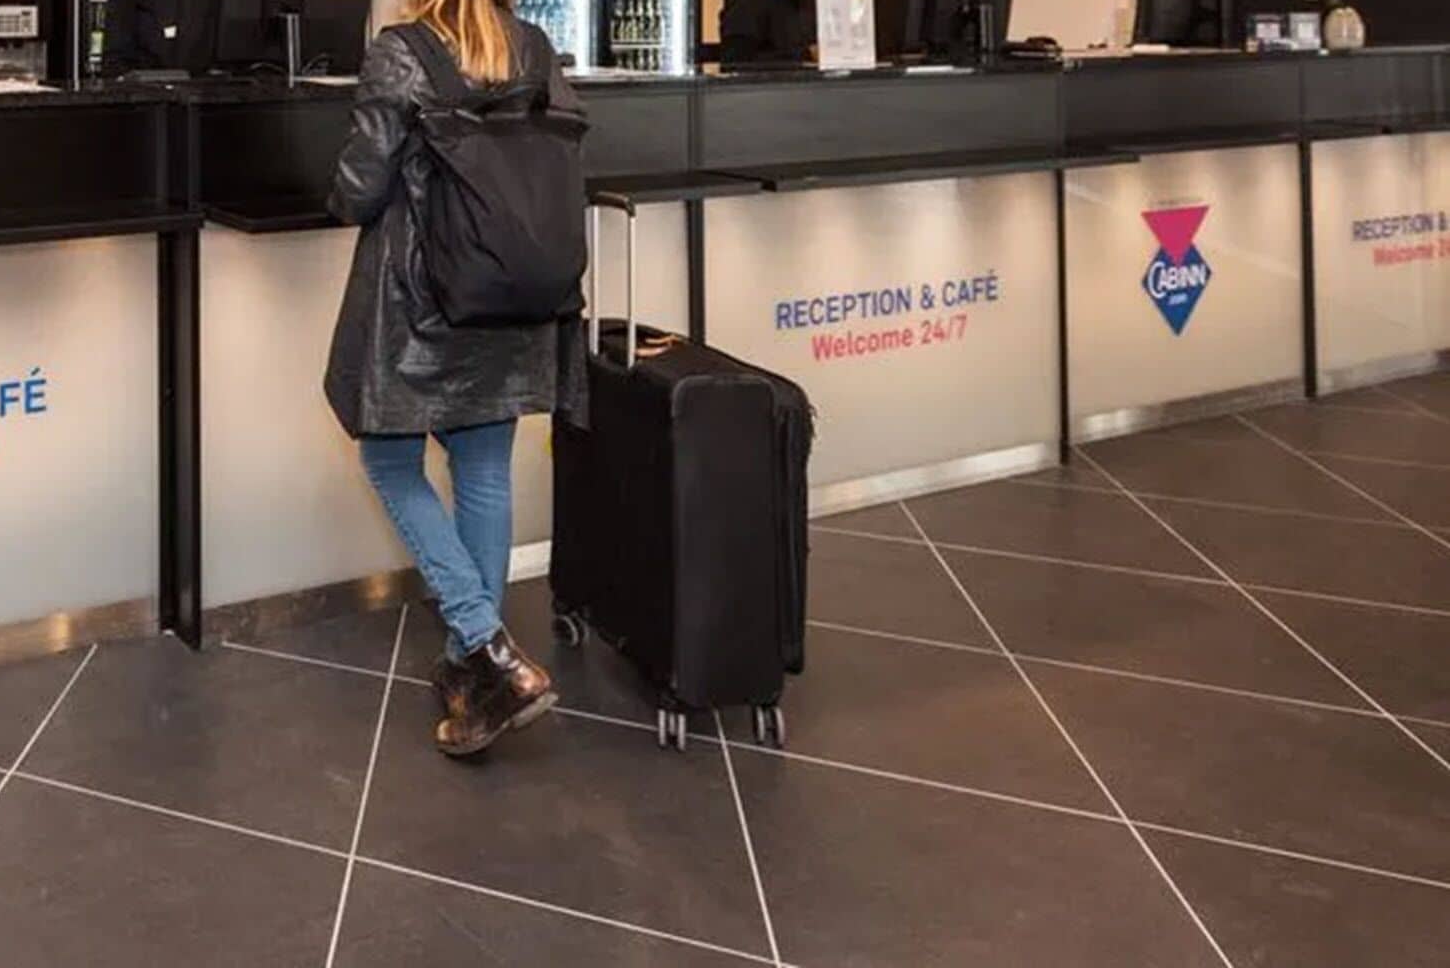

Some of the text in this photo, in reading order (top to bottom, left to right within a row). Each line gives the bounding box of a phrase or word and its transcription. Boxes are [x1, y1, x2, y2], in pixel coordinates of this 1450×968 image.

[1352, 213, 1432, 241] RECEPTION
[775, 269, 1000, 331] RECEPTION & CAFÉ
[1148, 261, 1207, 299] CABINN
[812, 313, 968, 361] Welcome 24/7
